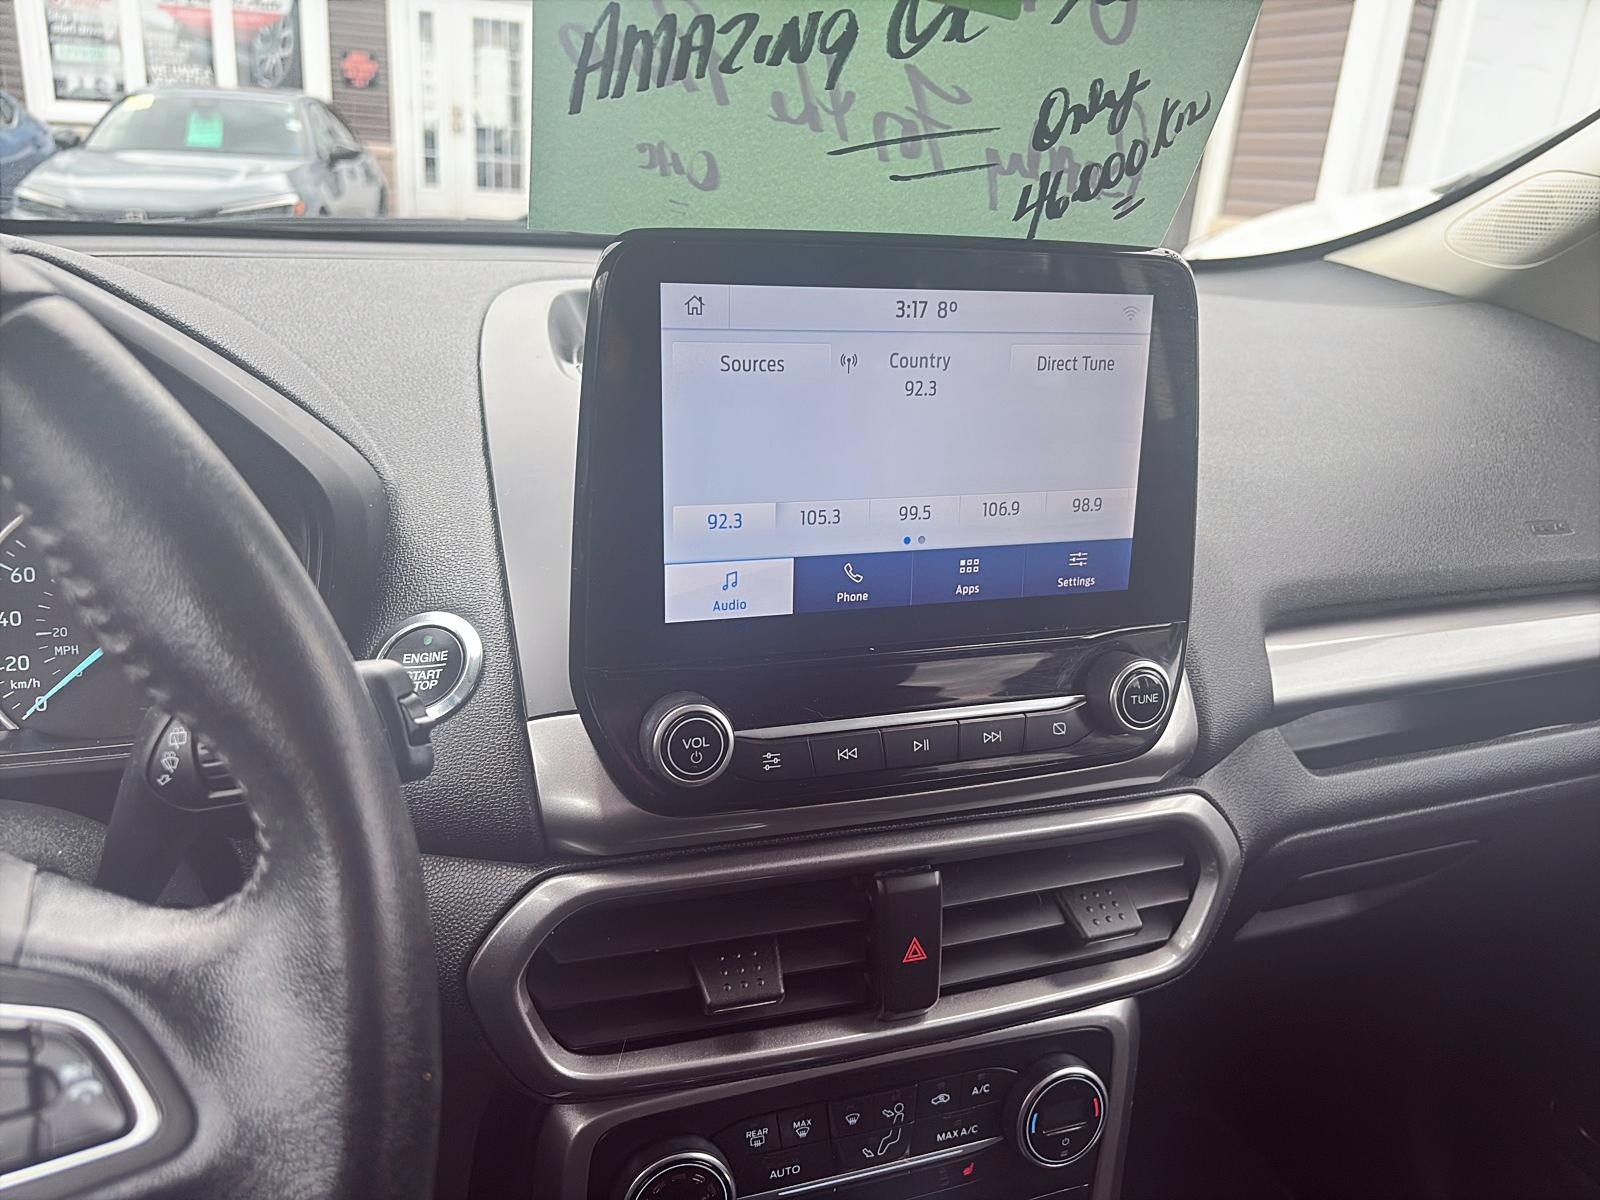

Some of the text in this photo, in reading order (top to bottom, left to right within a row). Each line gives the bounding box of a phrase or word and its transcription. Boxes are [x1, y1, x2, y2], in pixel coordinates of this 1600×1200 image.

[1032, 69, 1151, 151] Only
[895, 300, 928, 319] 3:17
[720, 355, 785, 372] Sources
[889, 352, 951, 372] Country
[1037, 355, 1115, 372] Direct Tune
[905, 380, 937, 397] 92.3
[899, 505, 931, 521] 99.5
[982, 501, 1020, 517] 106.9
[1072, 497, 1102, 513] 98.9
[707, 513, 743, 530] 92.3
[800, 509, 841, 526] 105.3
[10, 567, 36, 583] 60
[1057, 576, 1095, 589] Settings
[837, 592, 868, 603] Phone
[955, 584, 980, 597] Apps
[712, 599, 747, 612] Audio
[52, 627, 68, 638] 20
[54, 645, 79, 656] MPH
[403, 650, 449, 664] ENGINE
[5, 655, 30, 672] 20
[10, 678, 41, 690] km/h
[413, 680, 438, 692] TOP
[1130, 693, 1159, 705] TUNE
[682, 737, 710, 750] VOL
[971, 1083, 990, 1095] A/C
[793, 1118, 812, 1129] MAX
[746, 1127, 769, 1139] REAR
[936, 1124, 978, 1142] MAX A/C
[769, 1164, 801, 1180] AUTO
